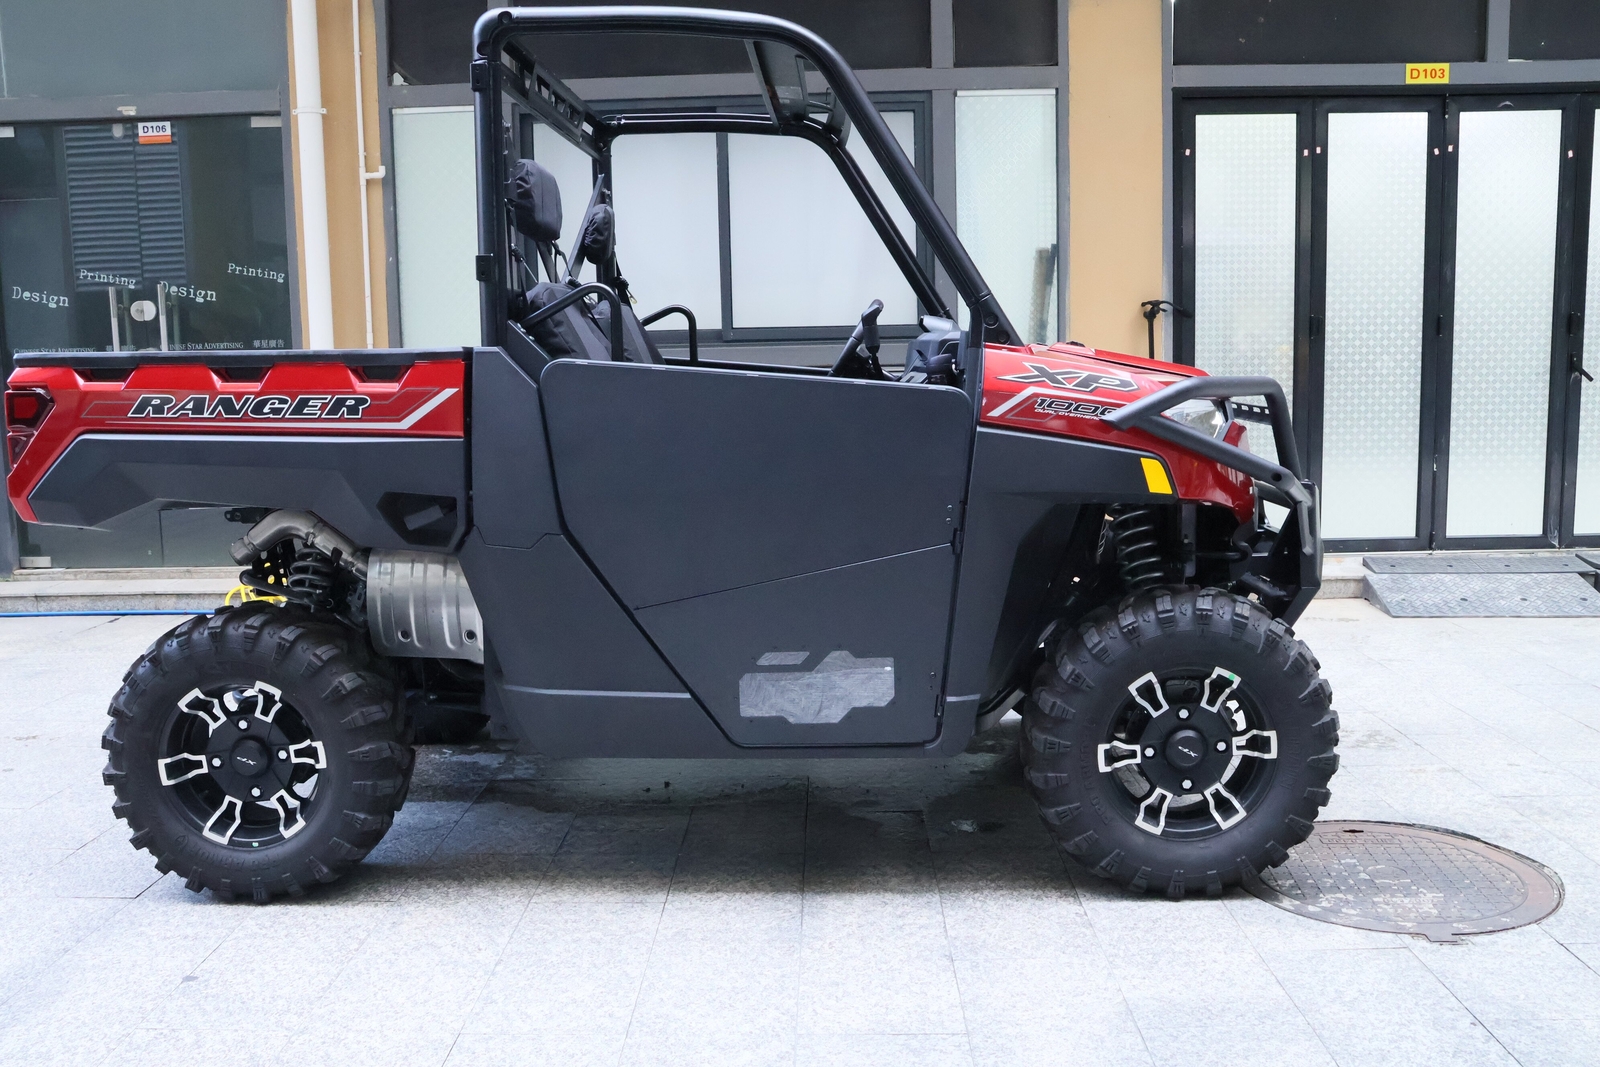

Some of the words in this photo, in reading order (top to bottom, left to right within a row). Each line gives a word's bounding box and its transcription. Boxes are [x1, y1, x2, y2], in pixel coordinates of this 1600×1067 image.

[1410, 68, 1445, 79] D103
[142, 125, 167, 134] D106
[80, 269, 136, 289] Printing
[227, 263, 285, 283] Printing
[12, 286, 69, 308] Design
[204, 342, 244, 350] ADVERTISING
[996, 361, 1140, 392] XP
[128, 394, 371, 419] RANGER
